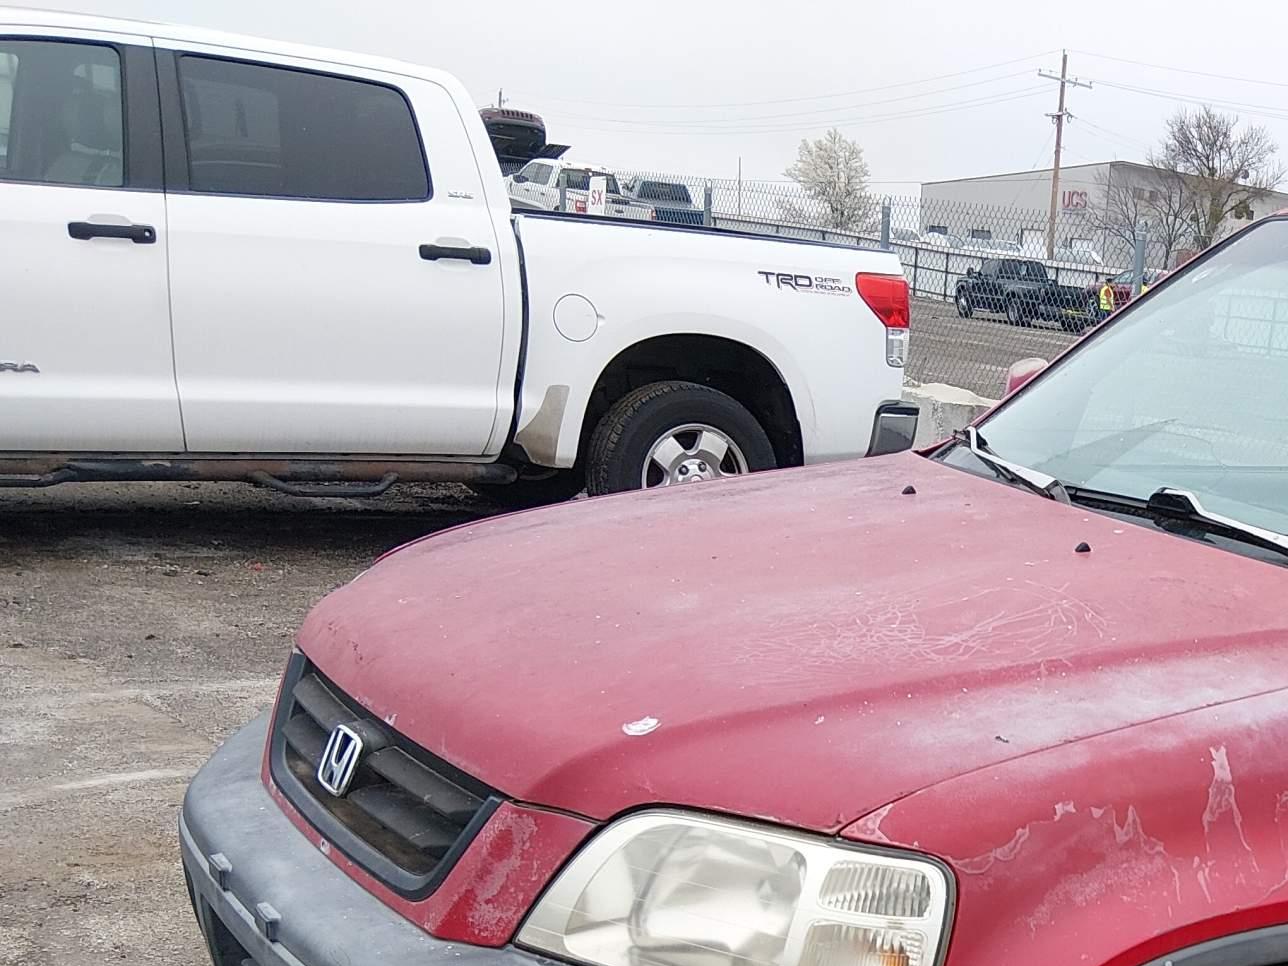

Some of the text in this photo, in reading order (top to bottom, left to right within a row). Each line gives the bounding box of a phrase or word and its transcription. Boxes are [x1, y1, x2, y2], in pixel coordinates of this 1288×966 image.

[591, 189, 604, 206] SX
[1062, 190, 1088, 209] UCS
[757, 270, 813, 292] TRD
[814, 276, 842, 285] OFF
[815, 284, 852, 294] ROAD
